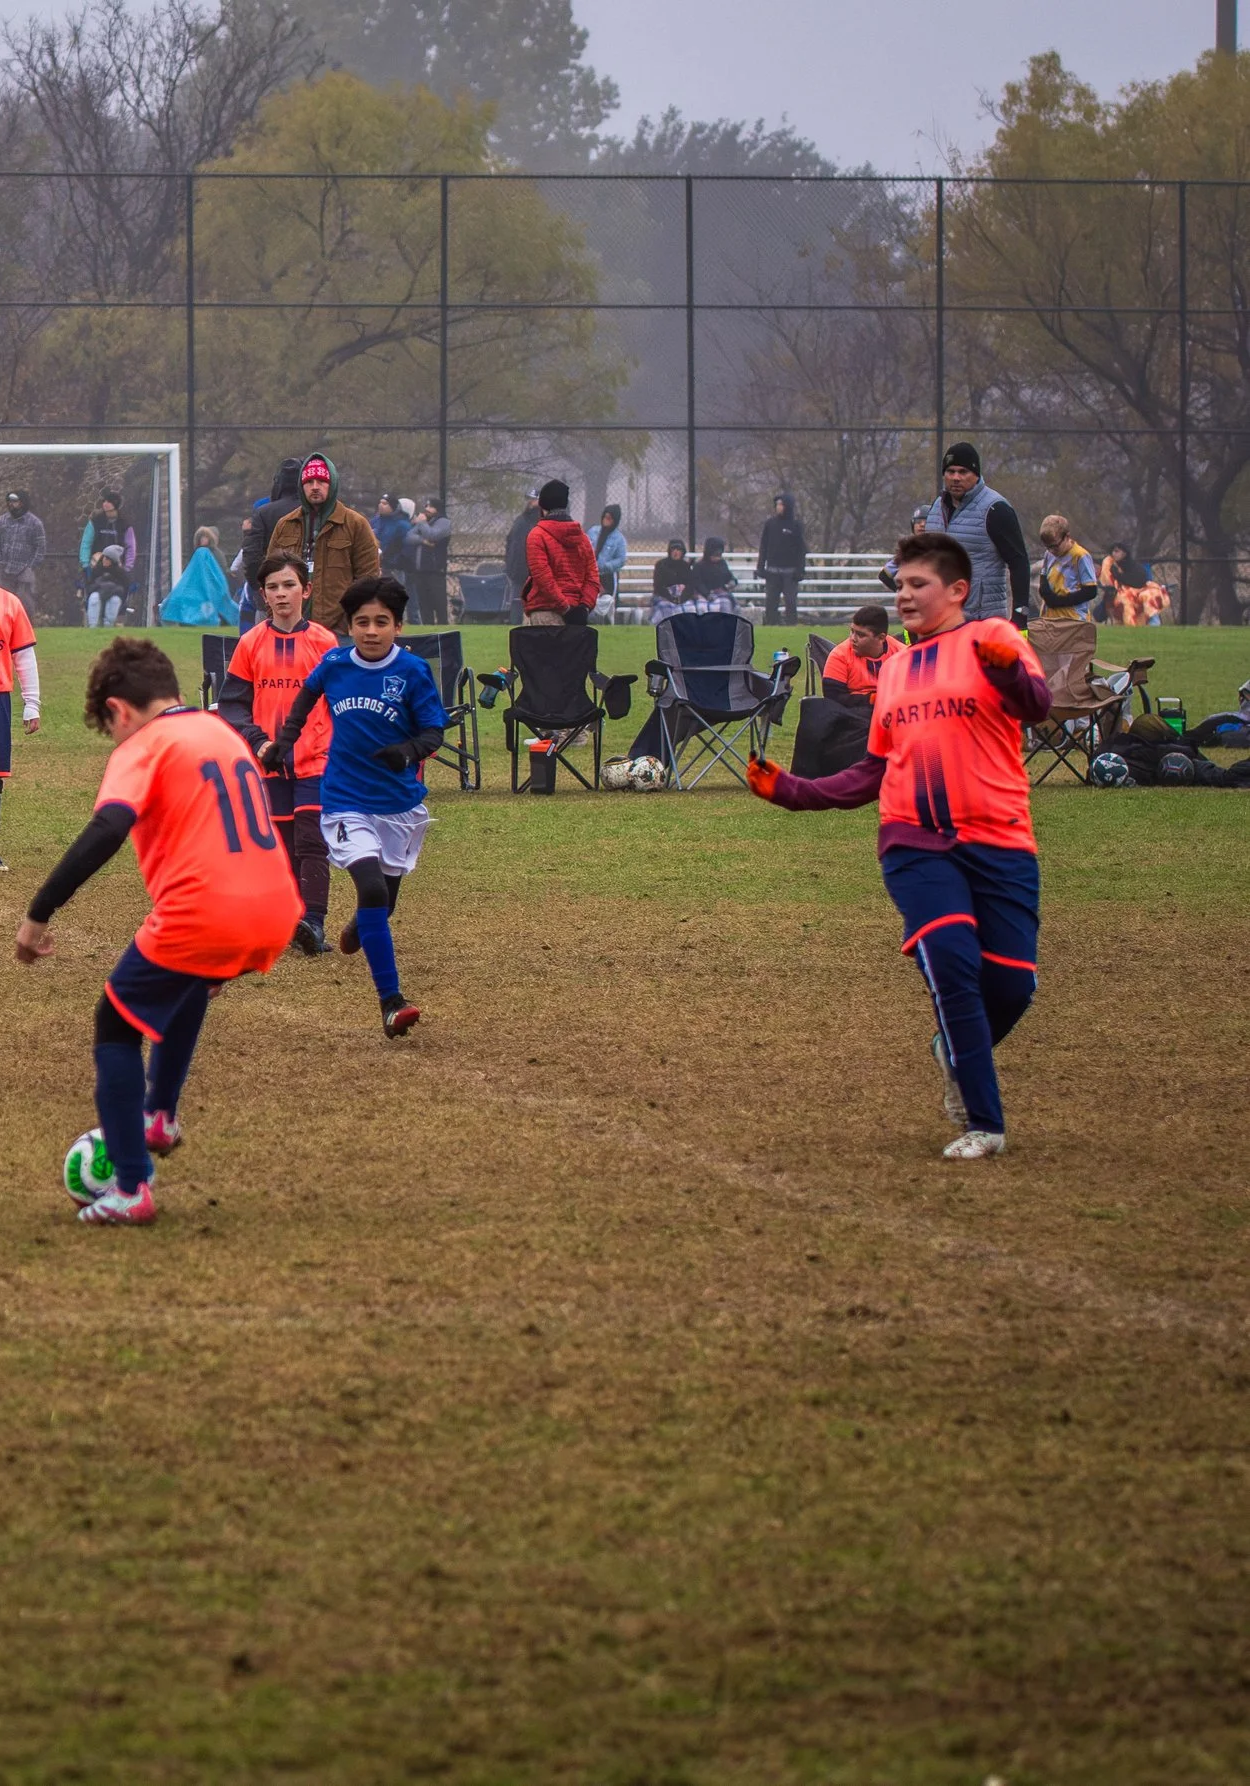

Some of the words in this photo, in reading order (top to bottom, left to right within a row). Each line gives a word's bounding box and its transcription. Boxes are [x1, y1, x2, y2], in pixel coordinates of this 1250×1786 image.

[333, 697, 385, 716] KINELEROS
[383, 706, 399, 722] FC
[200, 759, 277, 853] 10
